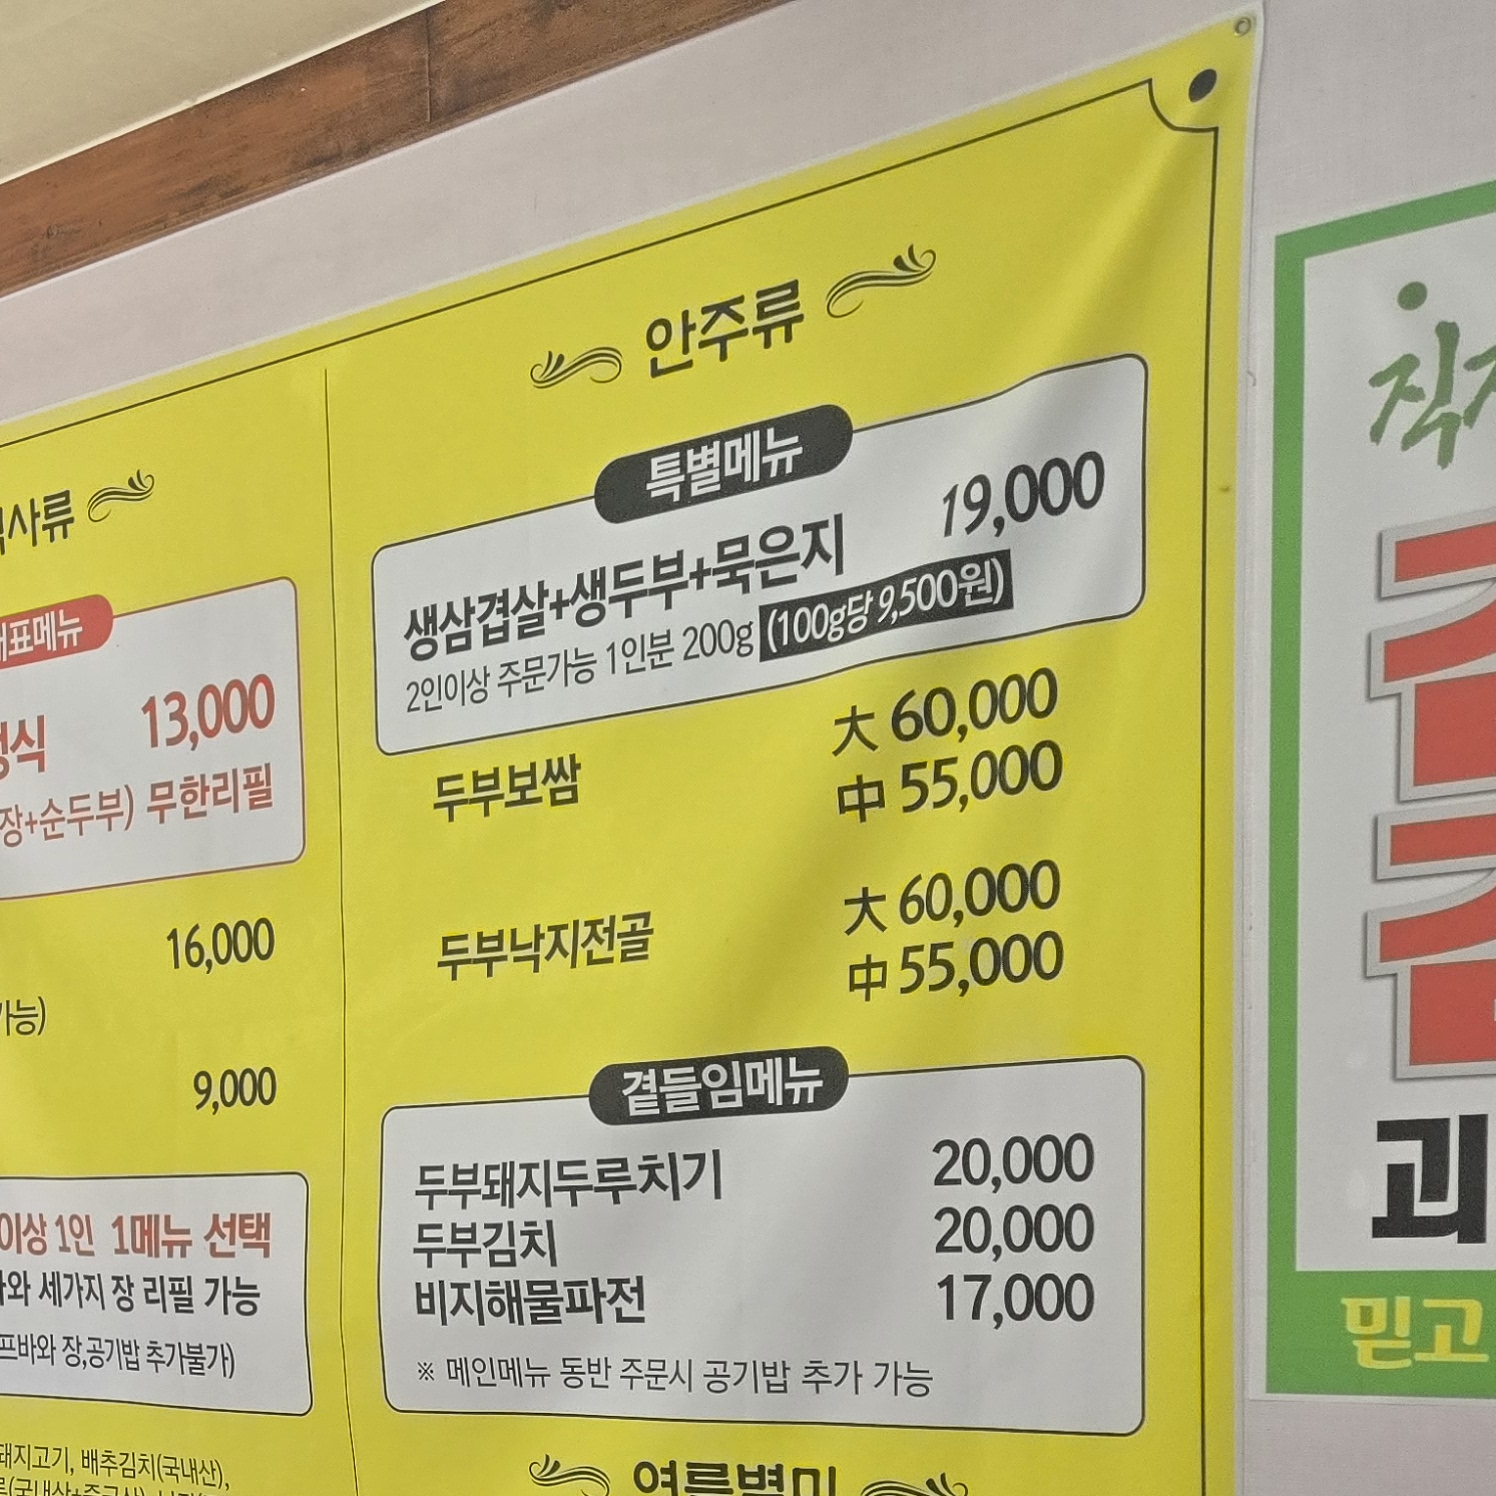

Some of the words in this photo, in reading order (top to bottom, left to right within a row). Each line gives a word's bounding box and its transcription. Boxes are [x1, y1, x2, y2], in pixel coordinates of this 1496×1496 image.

[645, 279, 804, 378] 안주류
[645, 428, 803, 504] 특별메뉴
[403, 513, 844, 662] 생삼겹살+생두부+묵은지
[942, 451, 1104, 538] 19,000
[406, 665, 490, 713] 2인이상
[497, 647, 597, 698] 주문가능
[606, 629, 675, 675] 1인분
[683, 618, 753, 661] 200g
[142, 674, 275, 753] 13,000
[832, 705, 879, 757] 大
[891, 666, 1059, 742] 60,000
[147, 763, 274, 824] 무한리필
[432, 753, 582, 822] 두부보쌈
[837, 778, 885, 823] 中
[901, 739, 1064, 815] 55,000
[844, 887, 886, 935] 大
[899, 859, 1061, 929] 60,000
[166, 918, 275, 974] 16,000
[437, 910, 654, 981] 두부낙지전골
[849, 956, 888, 1002] 中
[899, 929, 1064, 997] 55,000
[193, 1067, 277, 1114] 9,000
[622, 1057, 823, 1117] 곁들임메뉴
[414, 1149, 723, 1212] 두부돼지두루치기
[933, 1132, 1094, 1194] 20,000
[55, 1214, 95, 1257] 1인
[111, 1214, 192, 1258] 1메뉴
[204, 1212, 270, 1258] 선택
[413, 1220, 559, 1270] 두부김치
[934, 1203, 1095, 1262] 20,000
[39, 1271, 105, 1310] 세가지
[111, 1274, 134, 1312] 장
[143, 1275, 194, 1314] 리필
[205, 1276, 260, 1316] 가능
[414, 1276, 646, 1328] 비지해물파전
[936, 1272, 1094, 1331] 17,000
[146, 1340, 235, 1379] 추가불가)
[1341, 1296, 1489, 1370] 믿고
[446, 1357, 551, 1388] 메인메뉴
[559, 1357, 612, 1390] 동반
[619, 1358, 693, 1393] 주문시
[703, 1360, 790, 1394] 공기밥
[802, 1360, 863, 1395] 추가
[873, 1361, 933, 1397] 가능
